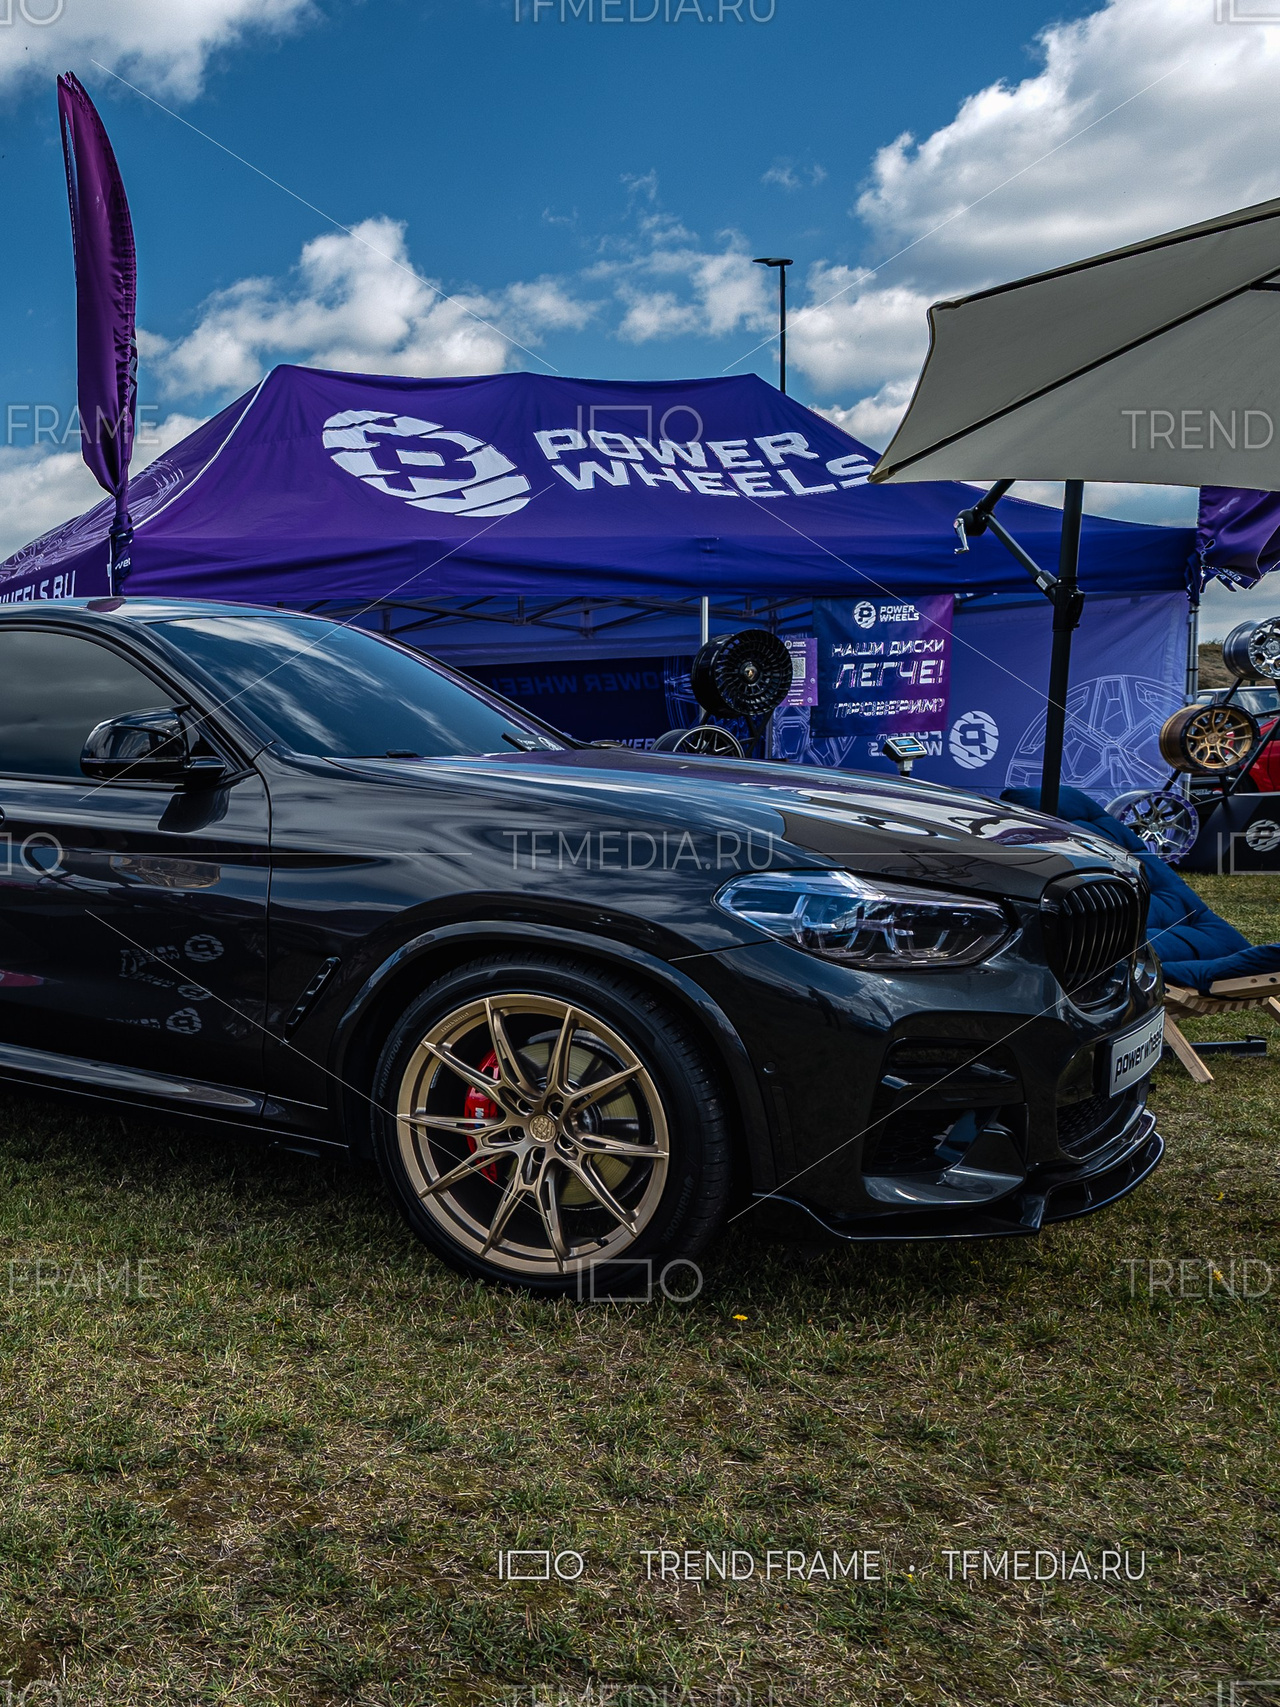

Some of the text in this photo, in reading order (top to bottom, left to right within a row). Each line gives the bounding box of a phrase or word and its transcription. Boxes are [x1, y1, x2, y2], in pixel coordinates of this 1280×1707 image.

[533, 427, 819, 469] POWER
[551, 453, 875, 498] WHEELS
[879, 604, 916, 615] POWER
[879, 612, 920, 622] WHEELS
[831, 639, 945, 657] НАШИ ДИСКИ
[832, 659, 945, 689] ЛЕГЧЕ!
[1114, 1043, 1145, 1083] power
